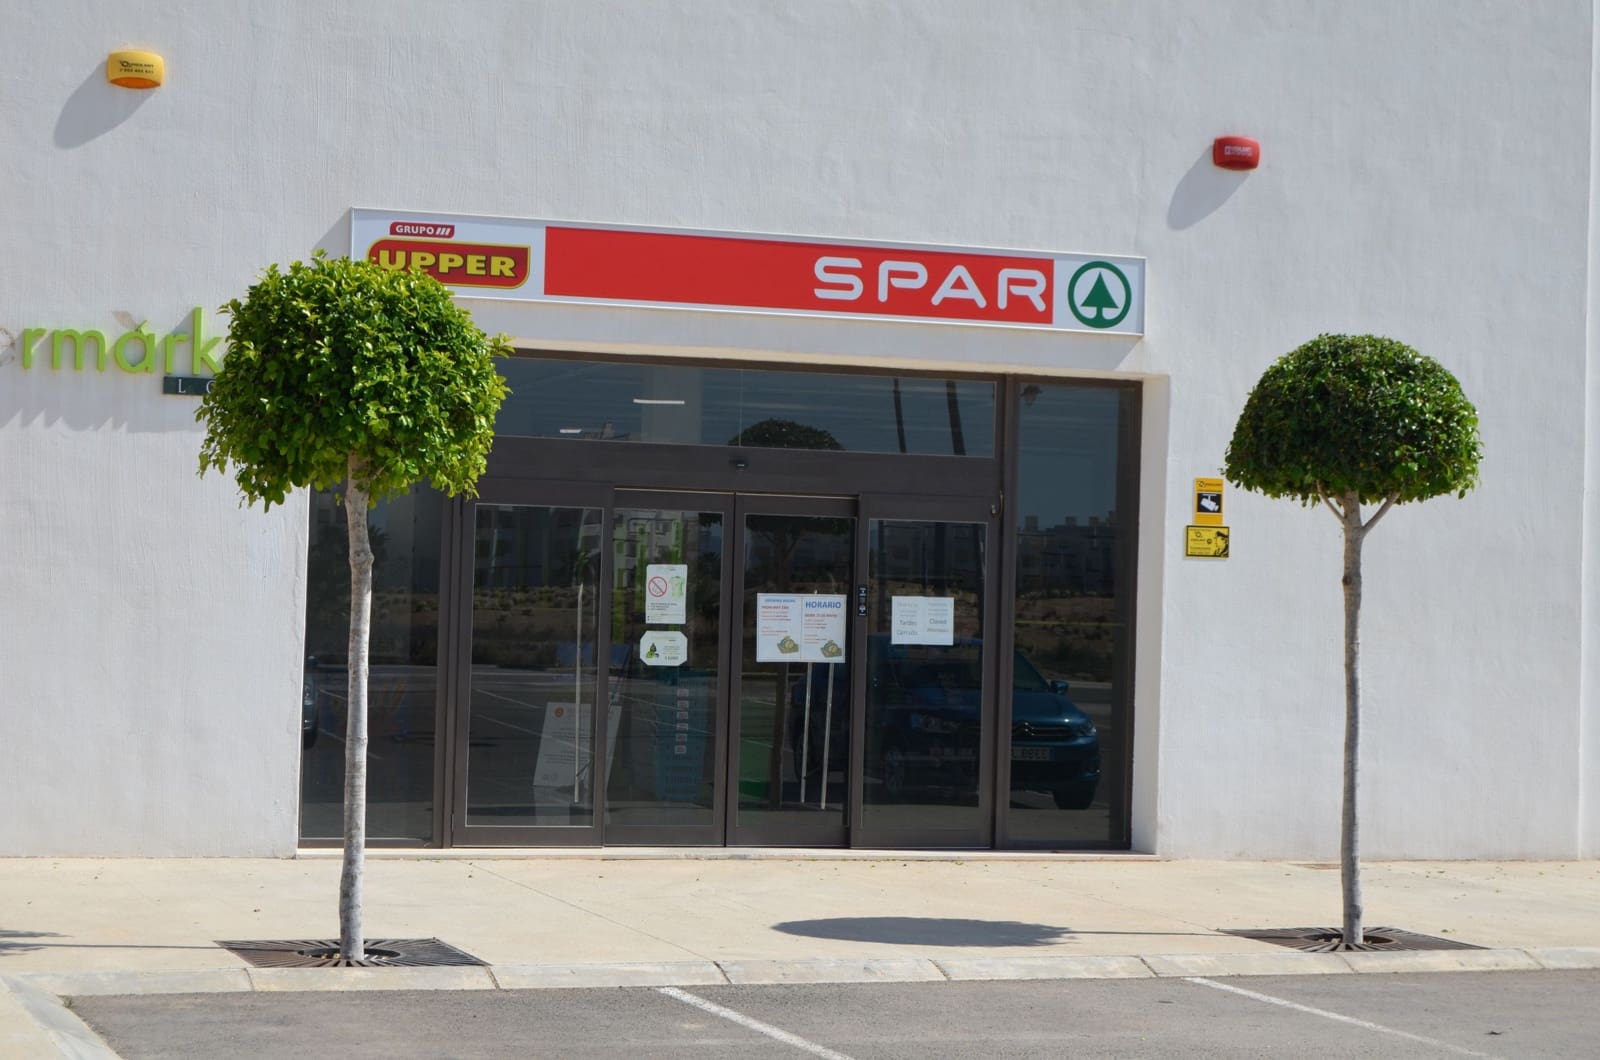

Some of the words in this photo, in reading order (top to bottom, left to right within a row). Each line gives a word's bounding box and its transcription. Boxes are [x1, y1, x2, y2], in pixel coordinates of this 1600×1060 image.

[396, 225, 435, 235] GRUPO
[379, 250, 516, 278] UPPER
[814, 256, 1046, 312] SPAR
[805, 600, 842, 609] HORARIO
